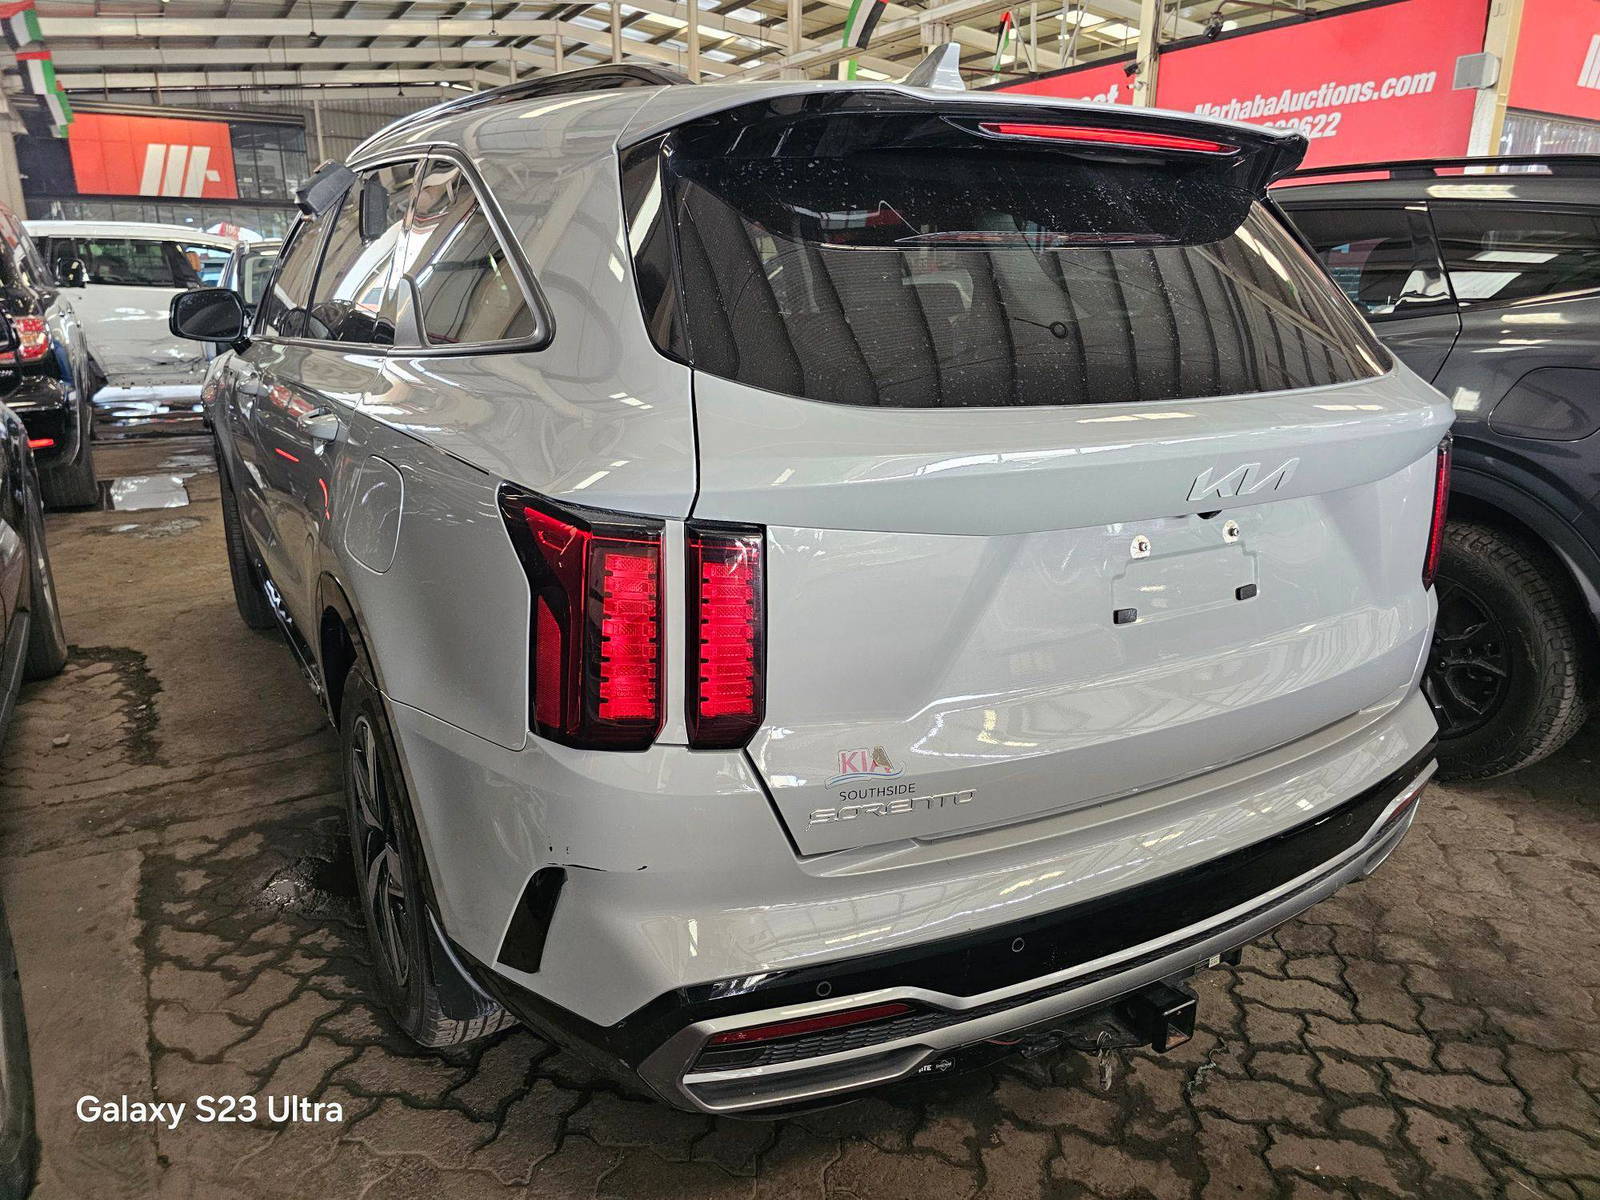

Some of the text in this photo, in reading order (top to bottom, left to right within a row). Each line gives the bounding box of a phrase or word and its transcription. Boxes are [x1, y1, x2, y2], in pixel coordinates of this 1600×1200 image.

[1194, 71, 1437, 122] MarhabaAuctions.com
[1264, 112, 1342, 138] 622
[838, 746, 893, 774] KIA
[839, 782, 916, 802] SOUTHSIDE
[806, 788, 977, 829] SORENTO
